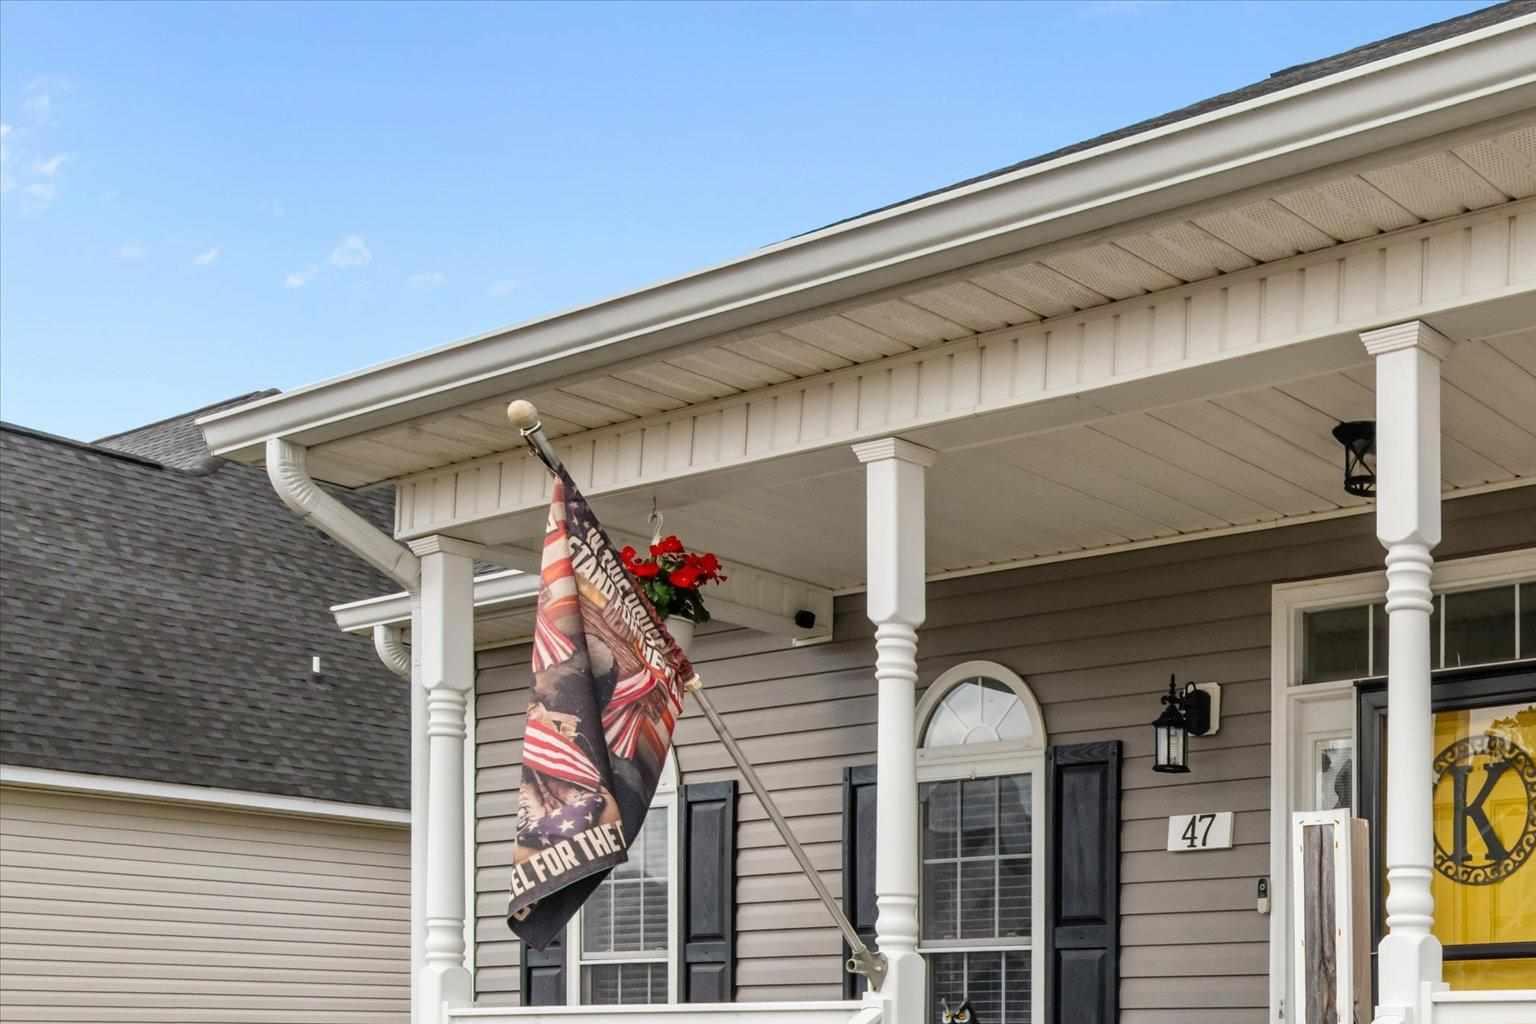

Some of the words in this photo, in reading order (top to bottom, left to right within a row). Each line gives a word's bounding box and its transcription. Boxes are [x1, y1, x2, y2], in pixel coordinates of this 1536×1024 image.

[567, 535, 617, 600] STAND
[528, 839, 580, 883] FOR
[573, 823, 621, 860] THE
[1182, 813, 1217, 848] 47
